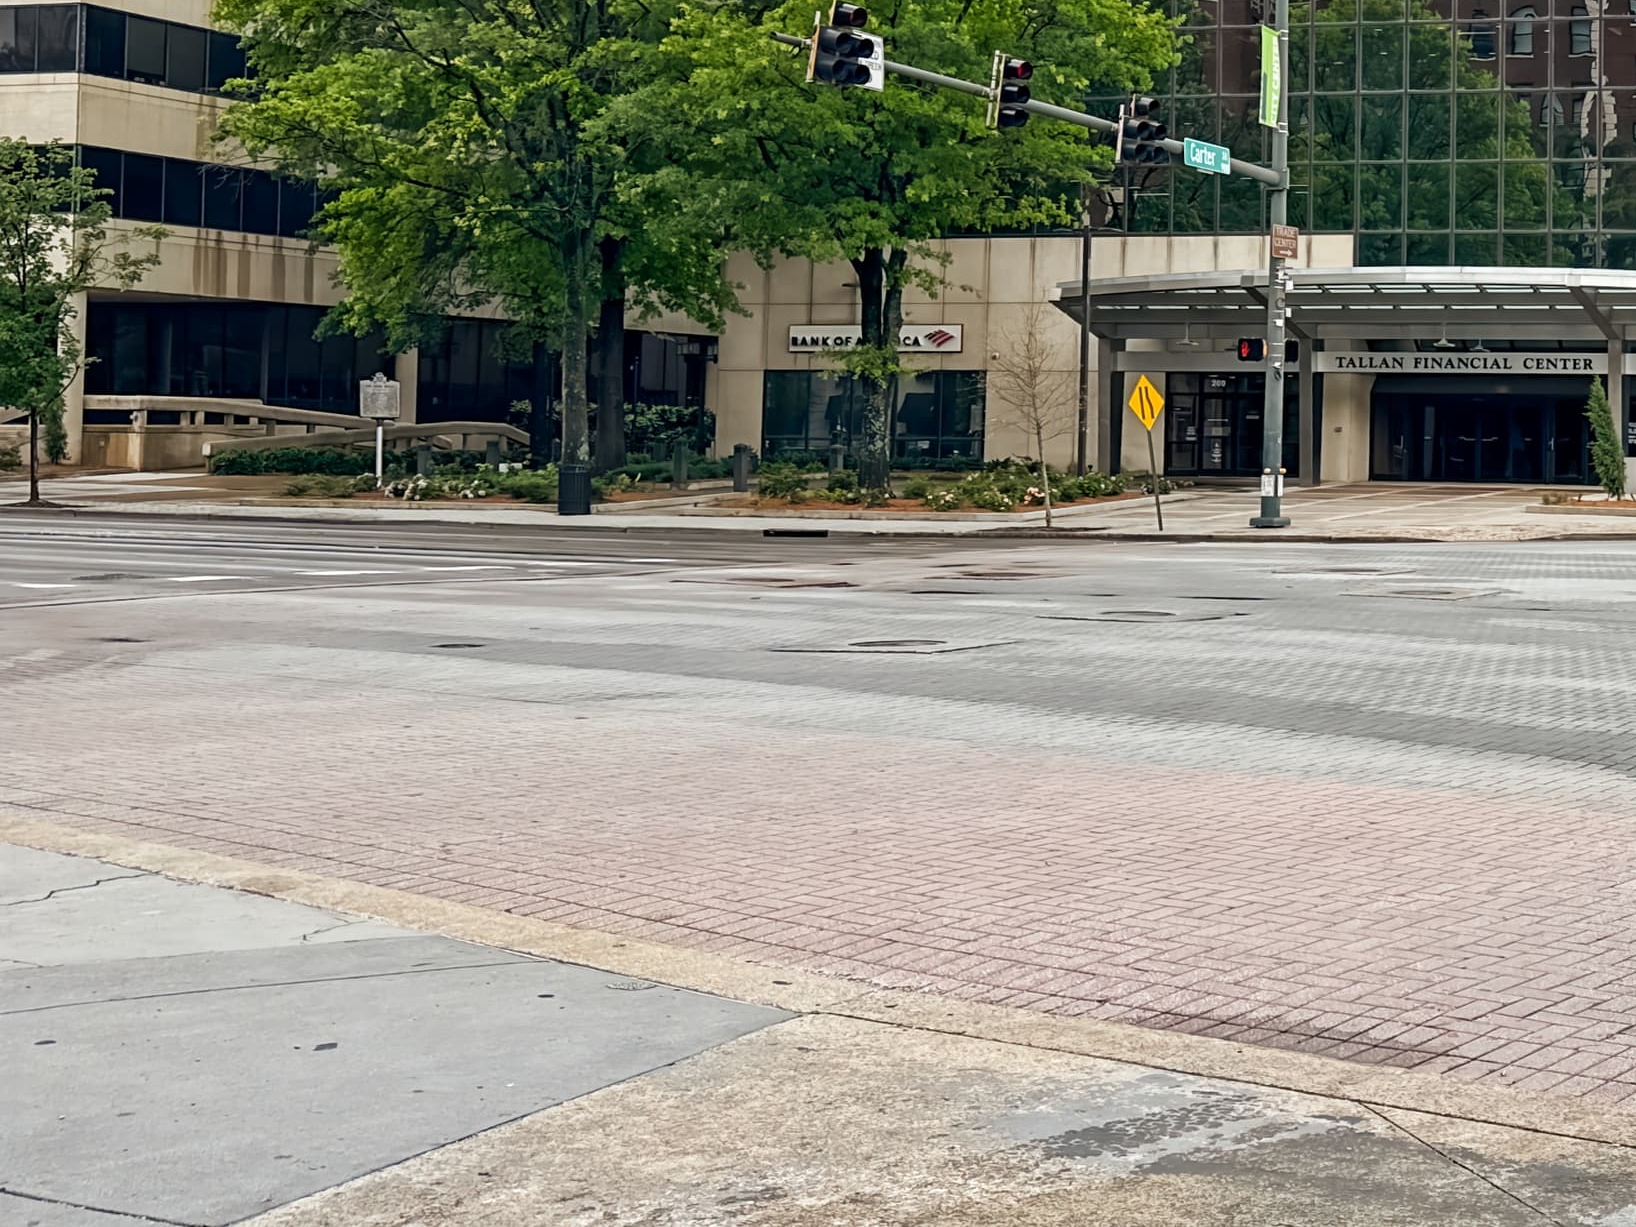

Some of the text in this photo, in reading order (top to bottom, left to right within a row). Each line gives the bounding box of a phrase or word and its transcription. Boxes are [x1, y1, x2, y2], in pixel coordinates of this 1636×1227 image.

[1190, 142, 1216, 166] Carter
[1273, 237, 1297, 249] CENTER
[791, 336, 830, 347] BANK
[833, 336, 853, 347] OF
[1335, 356, 1594, 371] TALLAN FINANCIAL CENTER
